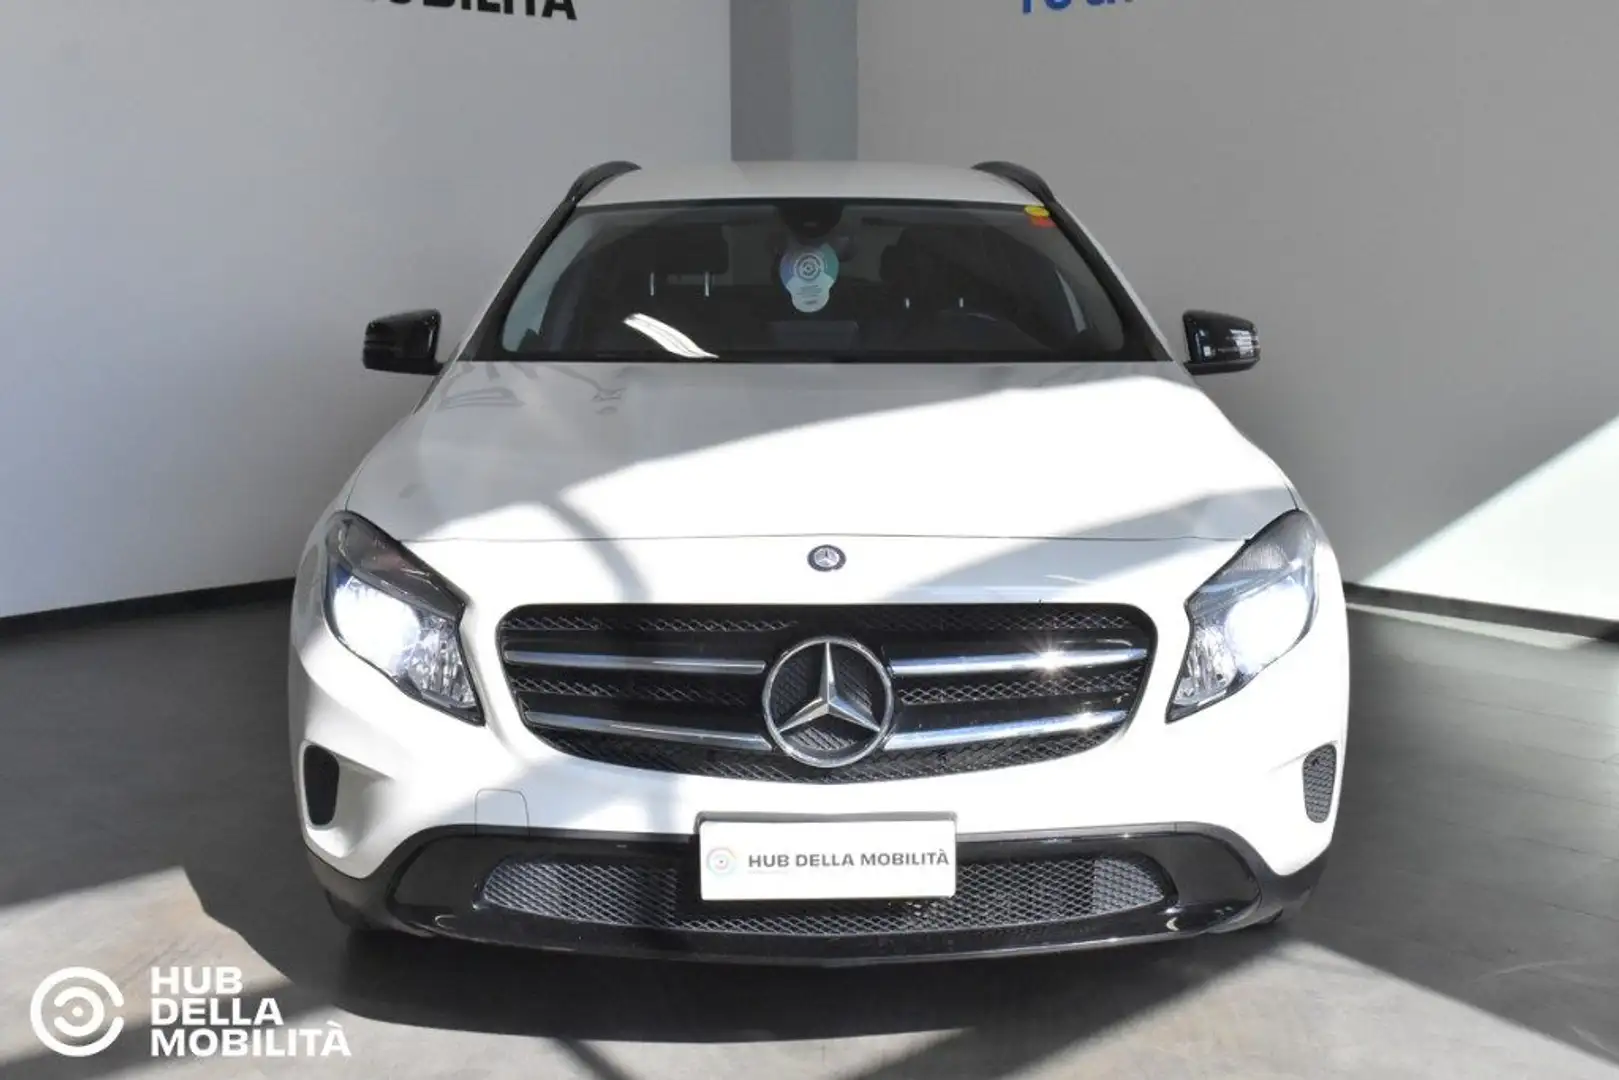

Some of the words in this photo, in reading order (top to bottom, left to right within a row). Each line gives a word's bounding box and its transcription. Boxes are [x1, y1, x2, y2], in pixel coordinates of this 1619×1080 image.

[749, 854, 789, 868] HUB
[795, 853, 854, 867] DELLA
[861, 849, 949, 866] MOBILITÀ
